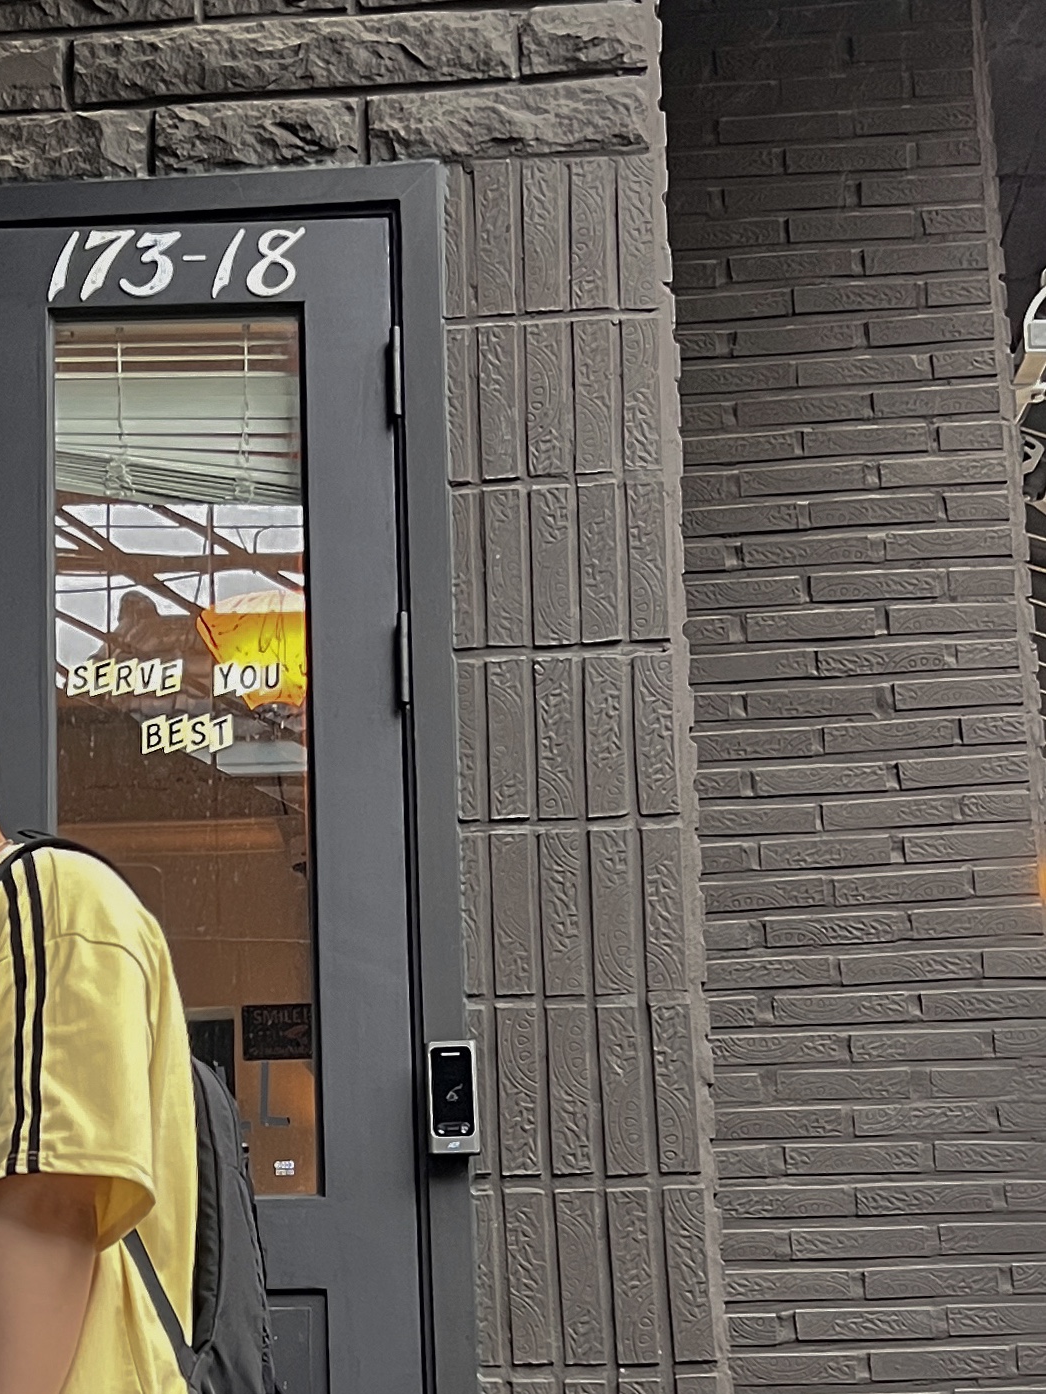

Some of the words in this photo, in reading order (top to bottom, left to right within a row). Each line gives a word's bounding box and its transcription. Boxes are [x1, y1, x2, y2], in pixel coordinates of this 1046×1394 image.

[48, 227, 305, 301] 173-18
[72, 664, 178, 692] SERVE
[218, 662, 281, 690] YOU
[145, 718, 231, 752] BEST
